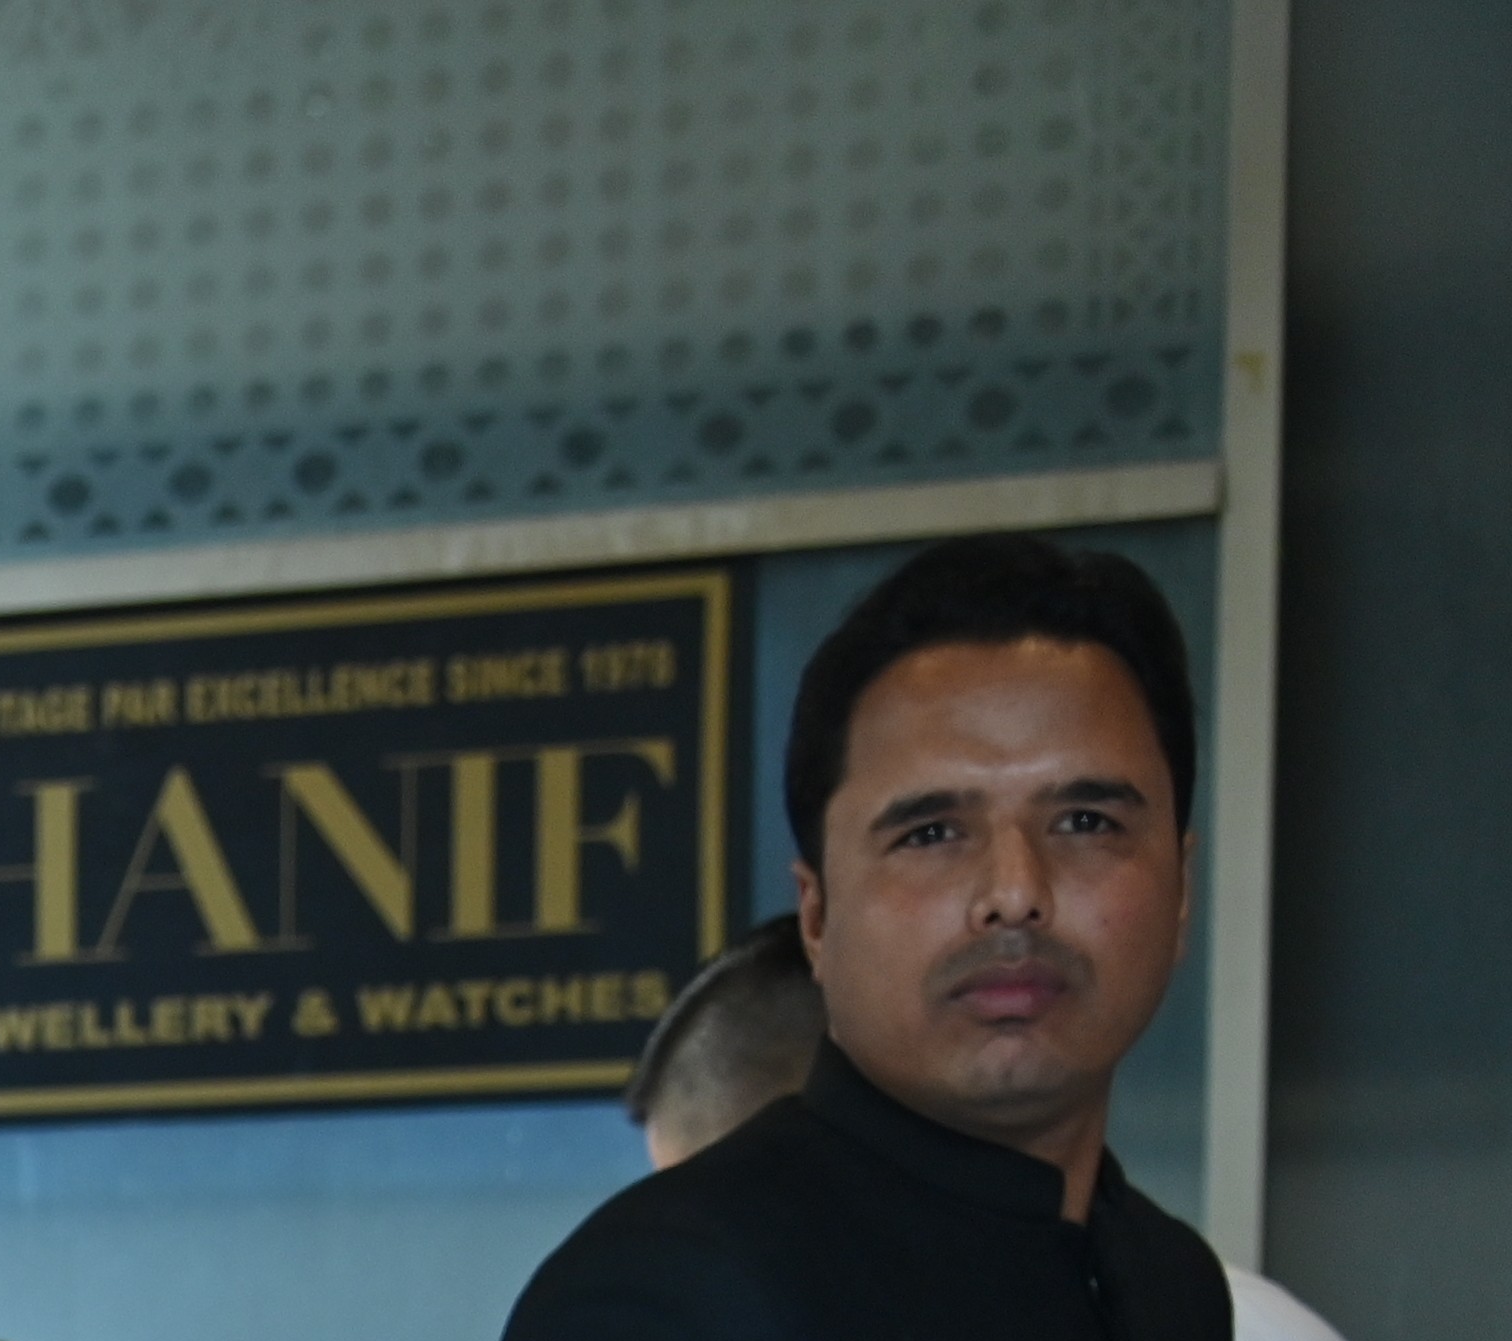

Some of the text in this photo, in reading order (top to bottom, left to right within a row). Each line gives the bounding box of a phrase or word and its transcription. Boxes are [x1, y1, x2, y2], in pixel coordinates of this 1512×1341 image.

[100, 678, 179, 729] PAR
[184, 658, 435, 724] EXCELLENCE
[445, 646, 568, 704] SINCE
[290, 986, 340, 1038] &
[356, 970, 669, 1034] WATCHES
